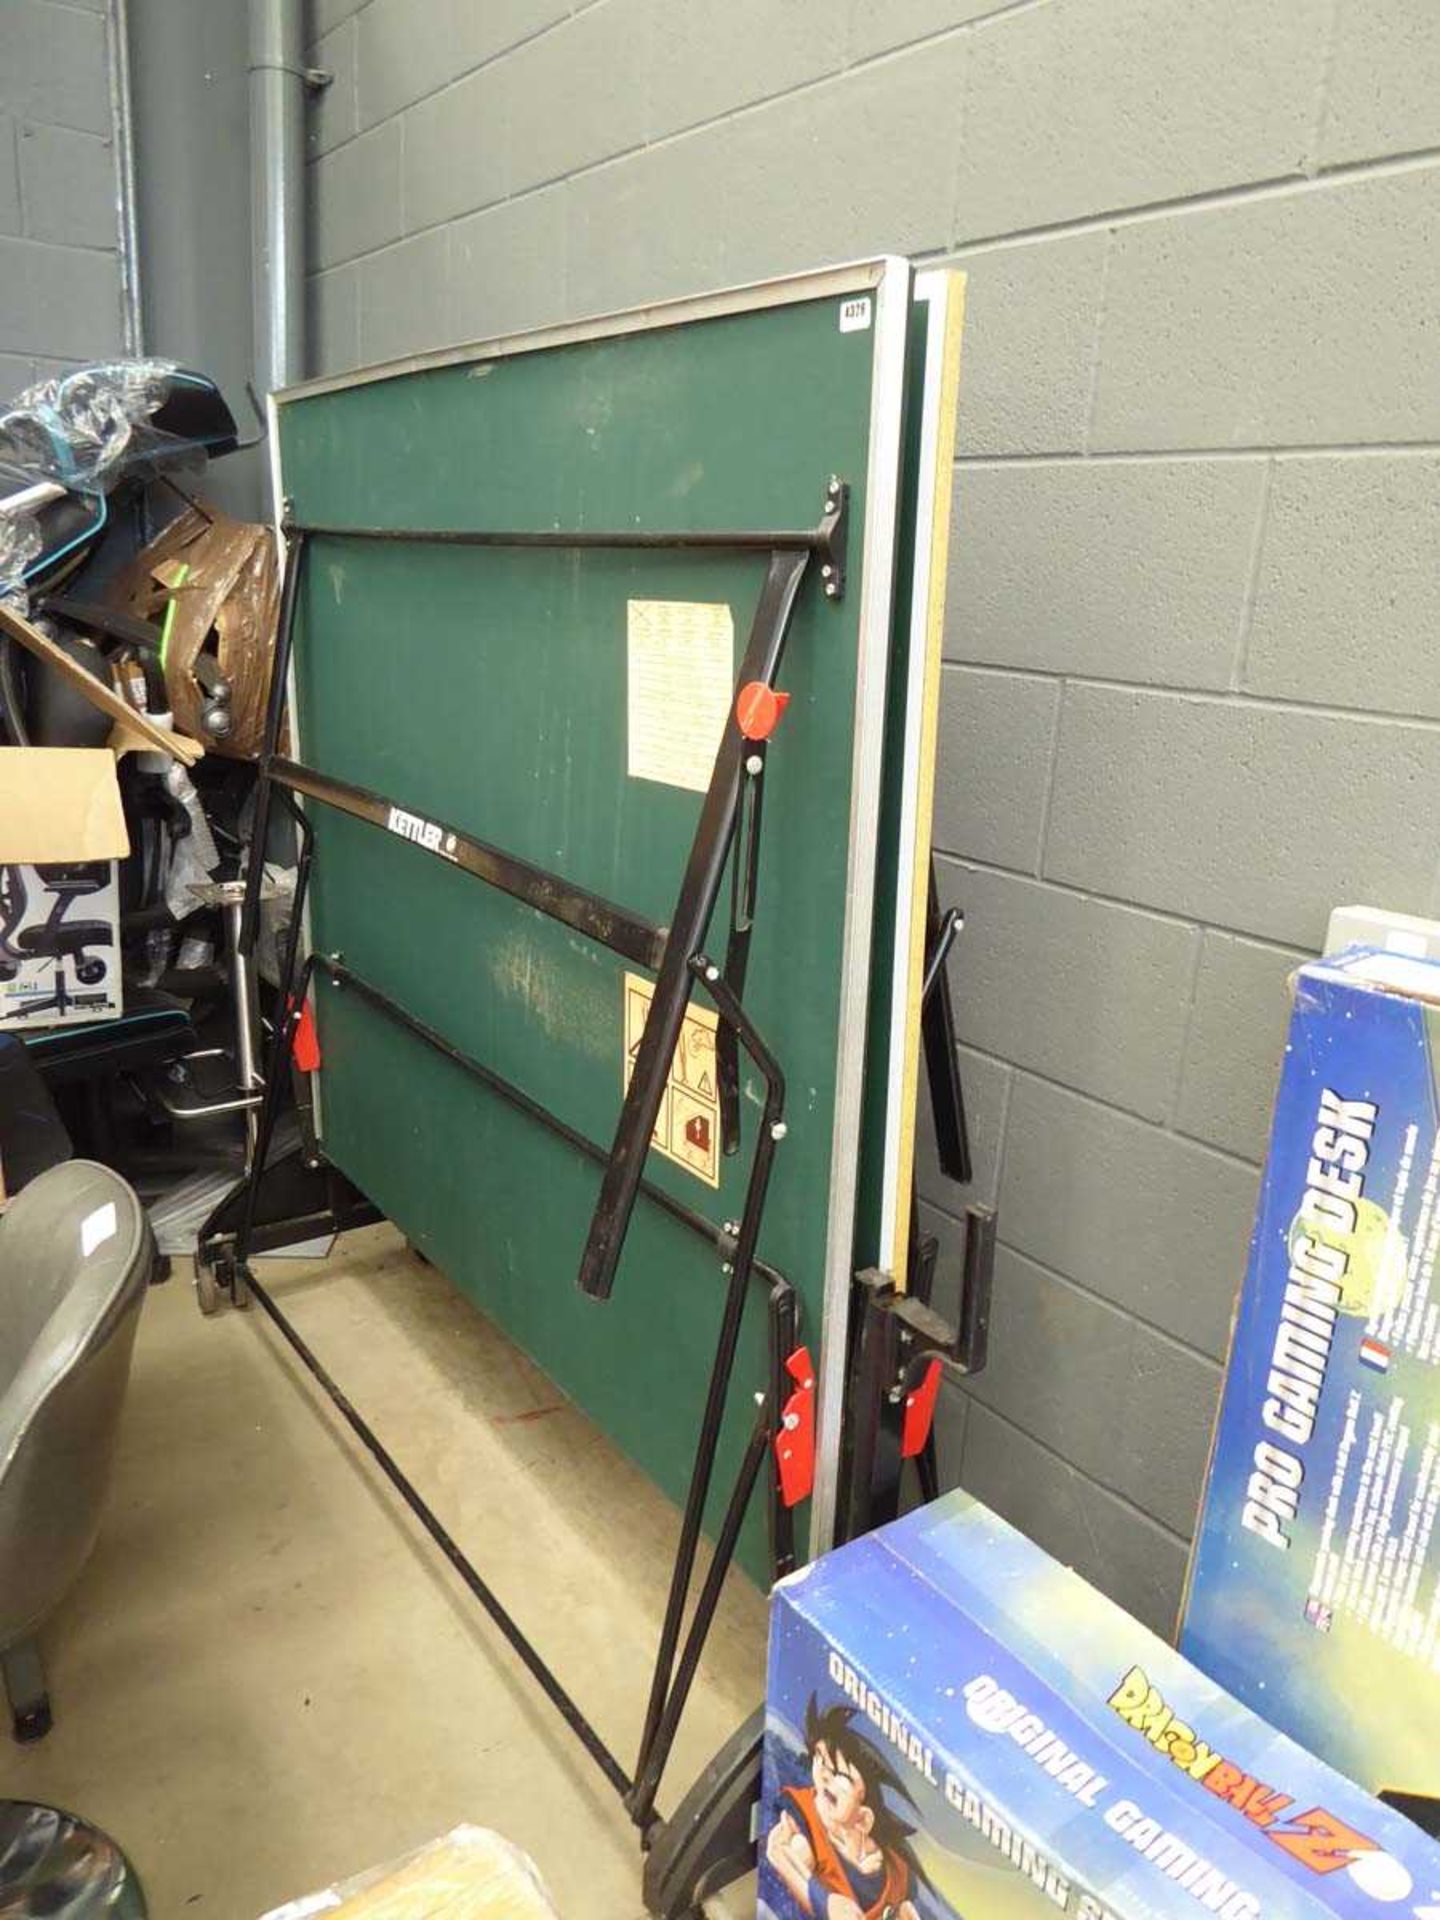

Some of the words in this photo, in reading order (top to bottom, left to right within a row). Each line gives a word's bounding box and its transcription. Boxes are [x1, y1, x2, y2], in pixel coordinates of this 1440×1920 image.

[388, 806, 457, 861] KETTLER
[1300, 1087, 1379, 1236] DESK
[1262, 1234, 1350, 1445] GAMING
[1241, 1440, 1304, 1550] PRO
[828, 1651, 938, 1787] ORIGINAL
[945, 1772, 1072, 1911] GAMING
[963, 1674, 1109, 1809] ORIGINAL
[1103, 1799, 1263, 1920] GAMING
